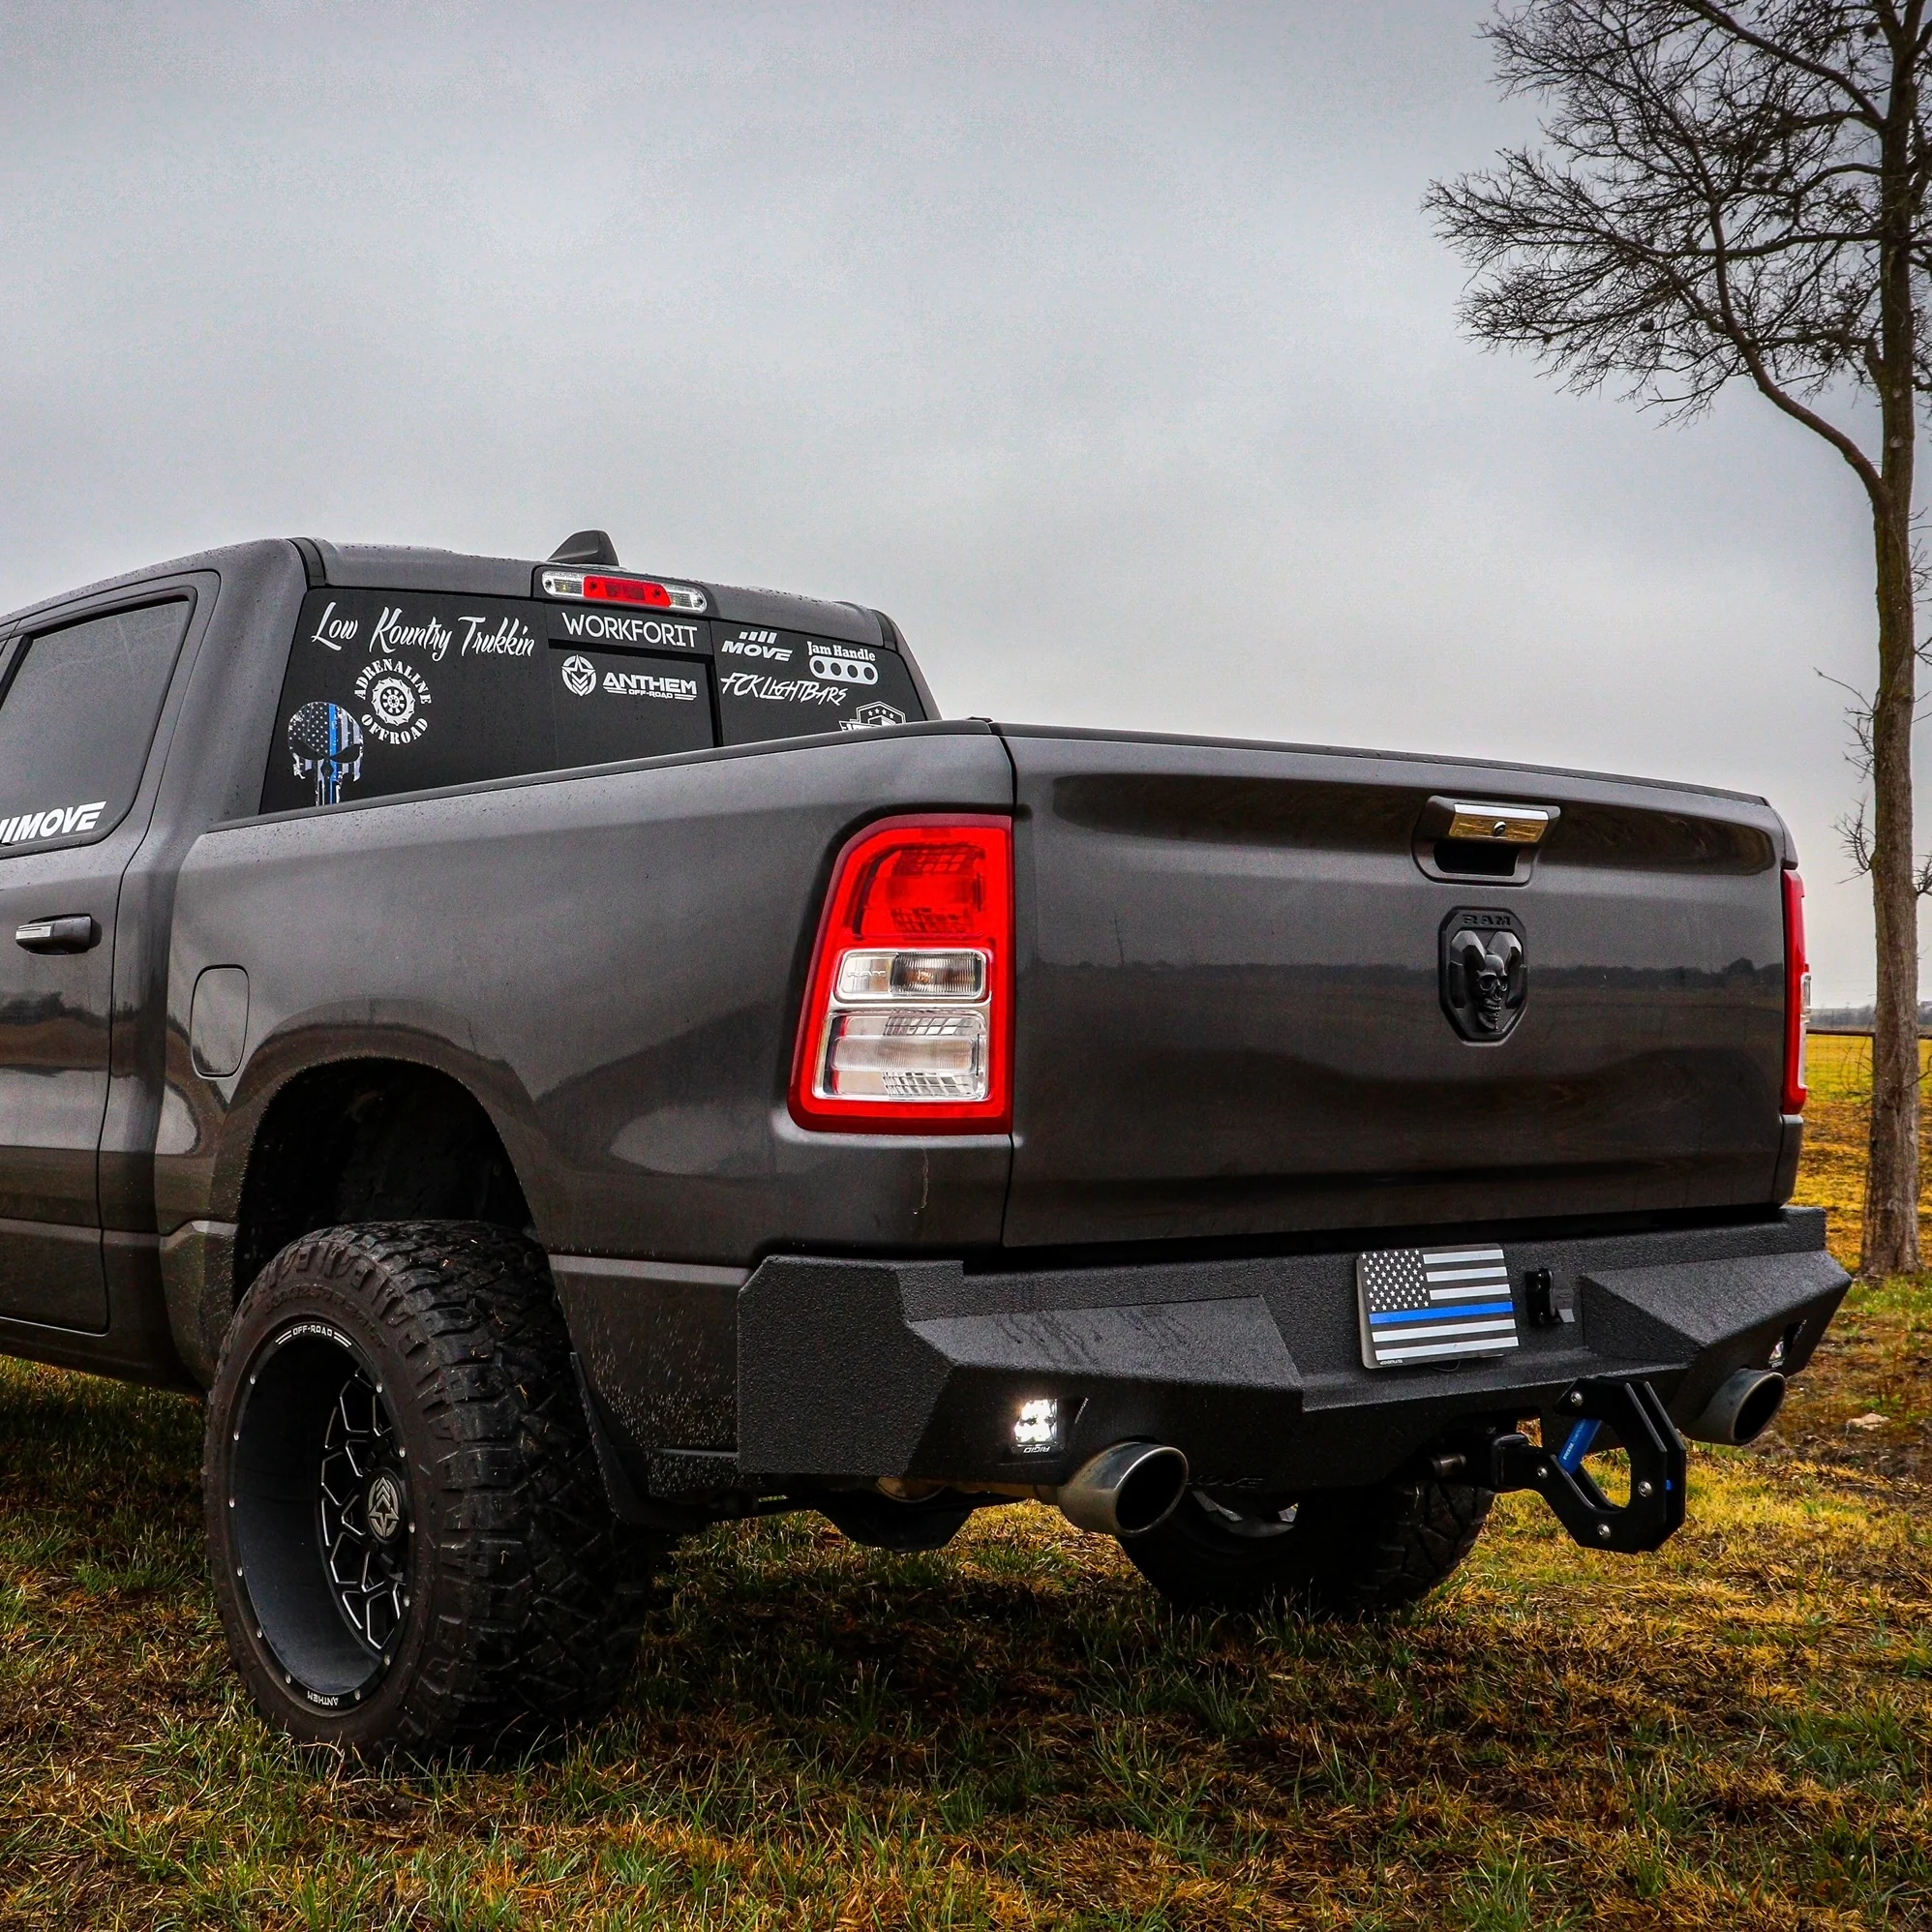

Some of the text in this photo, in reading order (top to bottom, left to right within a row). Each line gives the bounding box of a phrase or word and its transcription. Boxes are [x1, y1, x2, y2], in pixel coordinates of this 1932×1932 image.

[311, 601, 535, 662] Low Kountry Trukkin
[561, 612, 698, 648] WORKFORIT
[721, 641, 794, 662] MOVE
[806, 641, 876, 662] Jam Handle
[353, 658, 432, 706] ADRENALINE
[602, 672, 698, 695] ANTHEM
[628, 689, 674, 699] OFF-ROAD
[361, 713, 429, 745] OFFROAD
[12, 801, 107, 842] MOVE
[1462, 914, 1511, 926] RAM
[292, 1324, 333, 1337] OFF-ROAD
[1022, 1445, 1051, 1454] RIGID
[307, 1690, 339, 1706] ANTHEM
